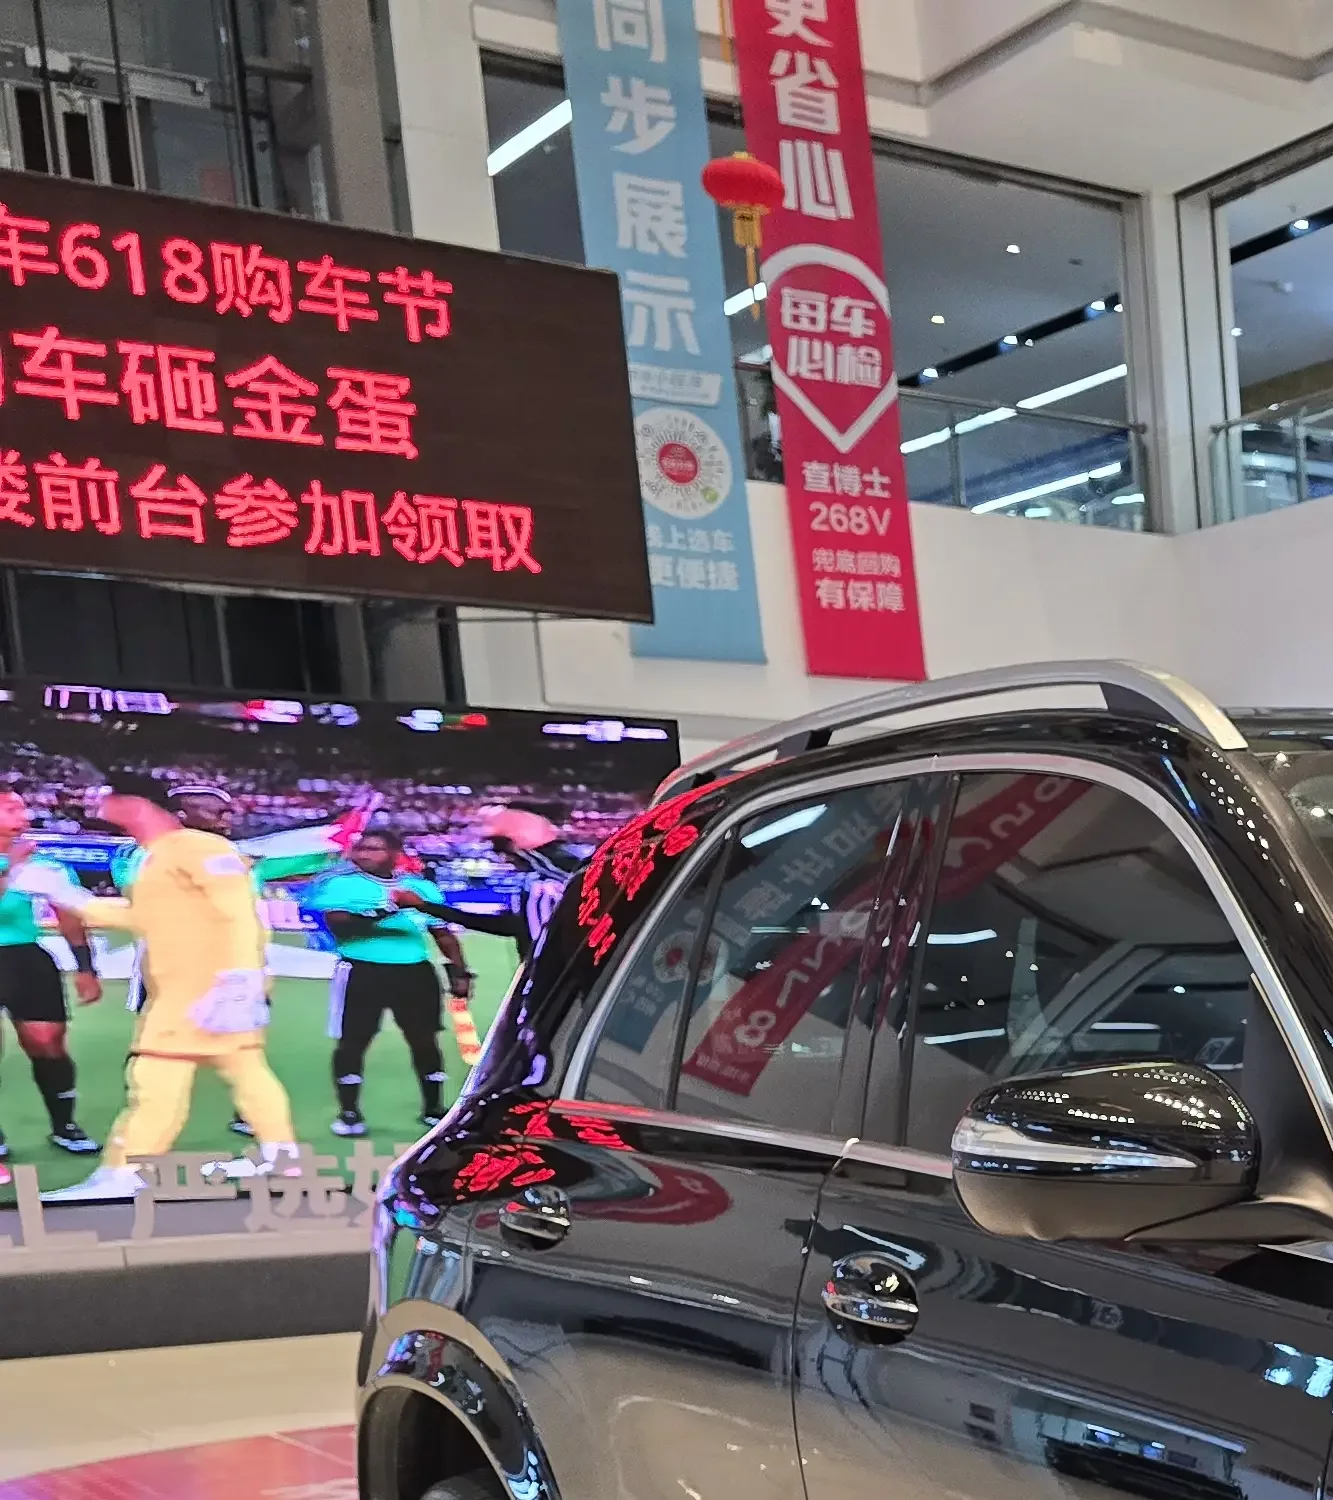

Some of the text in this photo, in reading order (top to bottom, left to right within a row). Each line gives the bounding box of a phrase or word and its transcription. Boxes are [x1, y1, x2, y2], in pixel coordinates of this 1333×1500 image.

[594, 0, 700, 356] 同步展示
[0, 204, 454, 344] 车618购车节
[787, 335, 883, 389] 必检
[0, 325, 419, 461] 车砸金蛋
[802, 460, 892, 498] 查博士
[809, 501, 893, 536] 268V
[815, 577, 906, 613] 有保障
